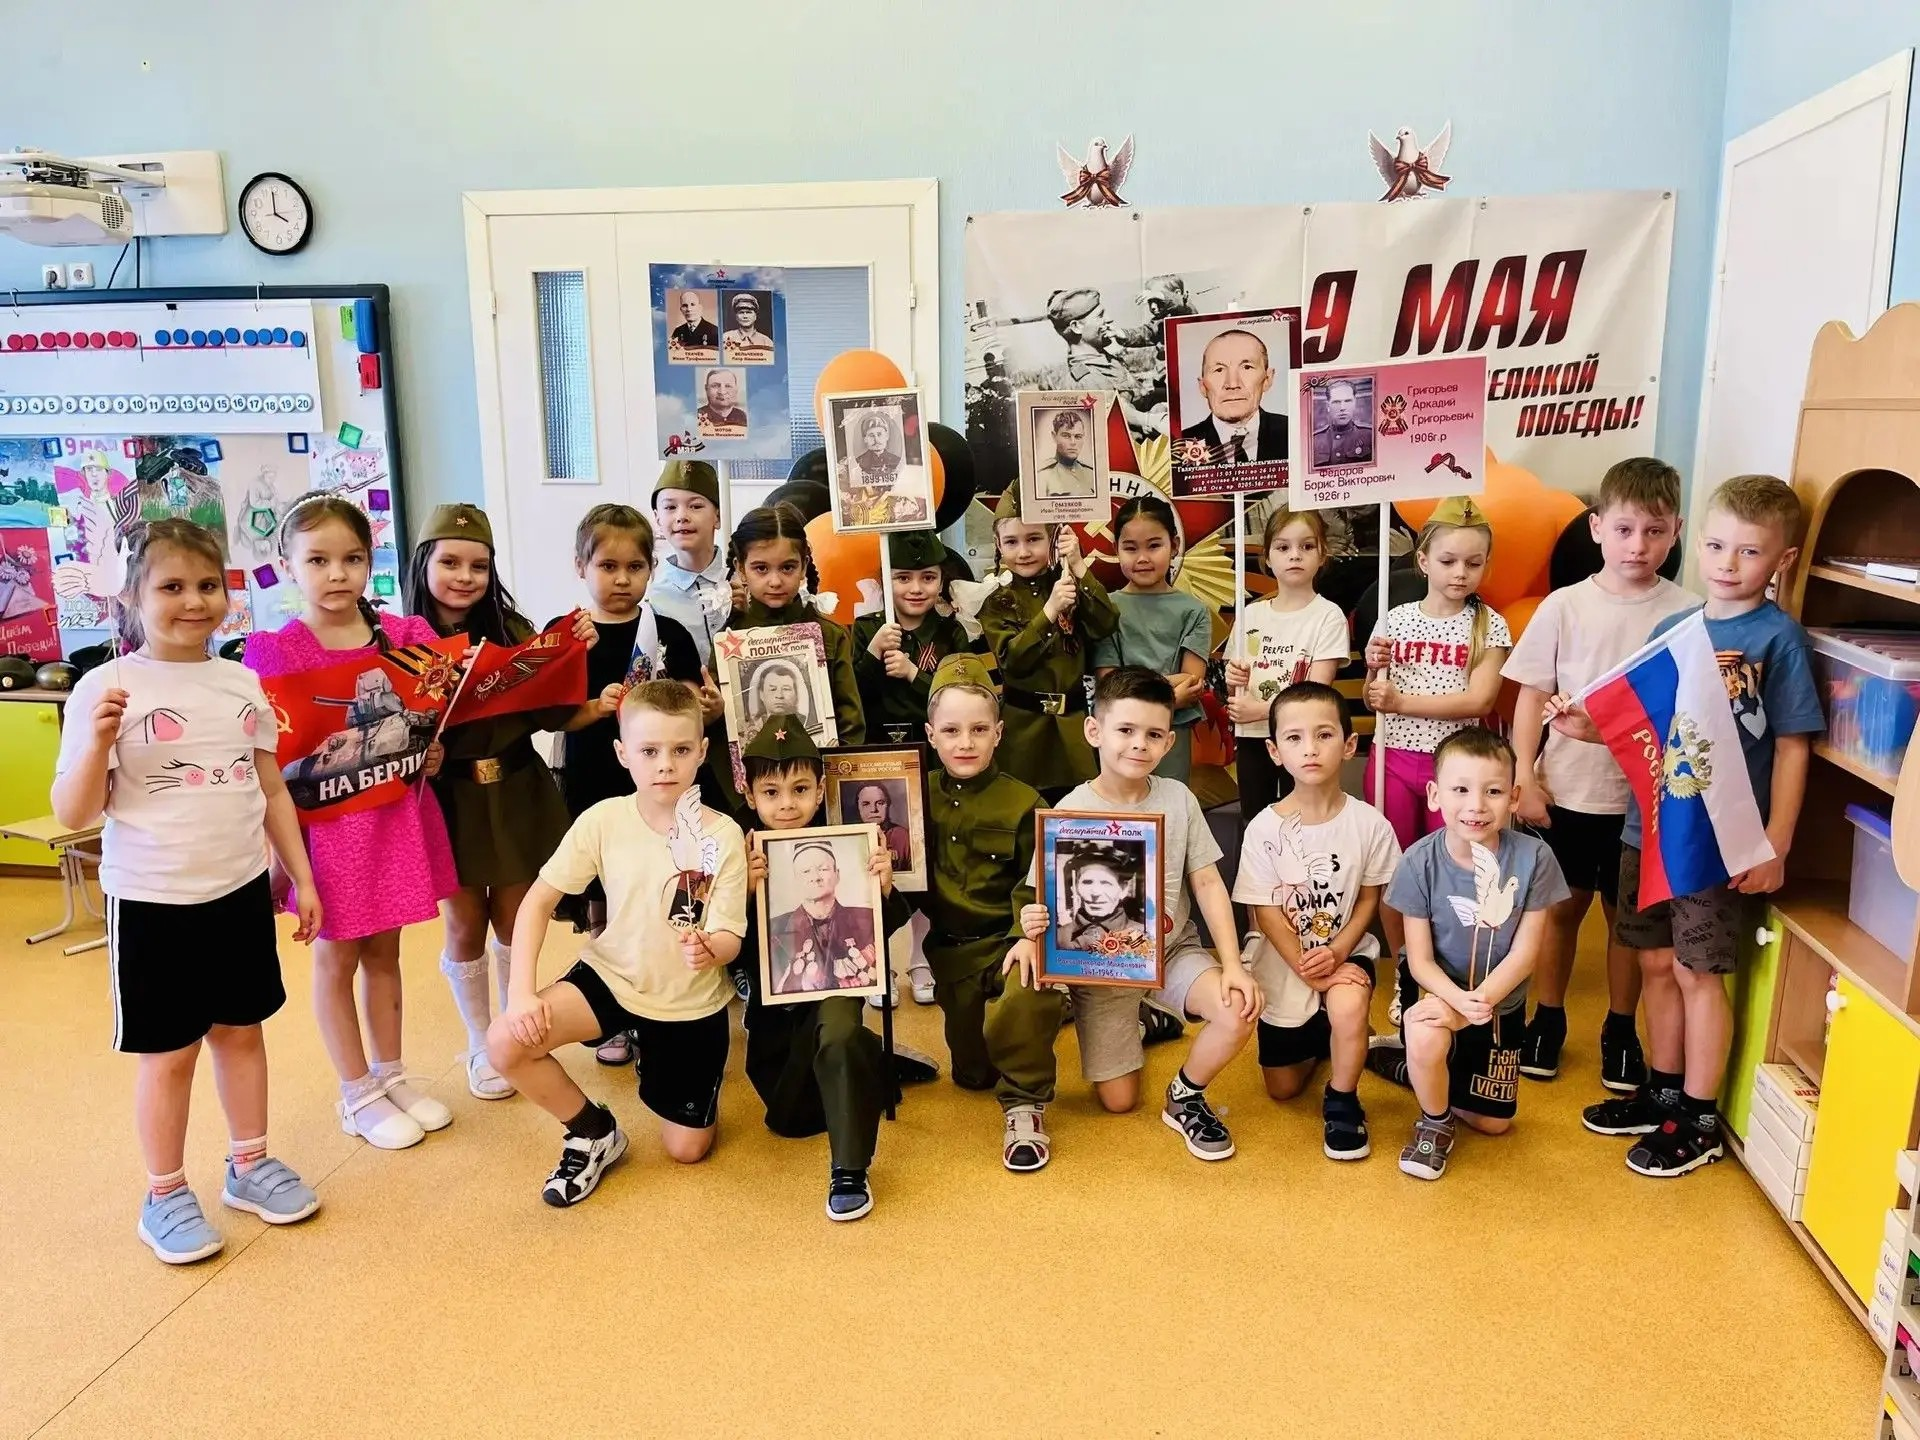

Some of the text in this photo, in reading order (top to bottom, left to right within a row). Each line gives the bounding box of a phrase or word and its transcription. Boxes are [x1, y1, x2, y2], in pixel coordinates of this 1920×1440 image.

[1302, 249, 1588, 365] 9 МАЯ
[1487, 353, 1600, 402] ЕЛИКОЙ
[1407, 384, 1459, 397] Григорьев
[16, 401, 22, 412] 3
[32, 402, 39, 410] 4
[49, 401, 55, 410] 5
[66, 401, 72, 410] 6
[83, 400, 89, 410] 7
[99, 400, 105, 410] 8
[117, 401, 124, 410] 9
[132, 400, 143, 409] 10
[149, 401, 158, 410] 11
[166, 401, 176, 409] 12
[182, 401, 193, 409] 13
[199, 400, 209, 409] 14
[216, 400, 227, 409] 15
[233, 398, 244, 407] 16
[249, 400, 259, 409] 17
[266, 401, 276, 410] 18
[281, 399, 292, 409] 19
[298, 399, 309, 409] 20
[1412, 398, 1456, 410] Аркадий
[1411, 412, 1474, 426] Григорьевич
[1515, 395, 1646, 439] ПОБЕДЫ!
[65, 437, 77, 456] 9
[1304, 474, 1396, 491] Борис Викторович
[1262, 645, 1294, 655] PERFECT
[1394, 641, 1470, 668] LITTLE
[319, 748, 428, 802] НА БЕРЛИ
[1488, 1065, 1517, 1080] UNTI
[1477, 1078, 1516, 1099] VICTO
